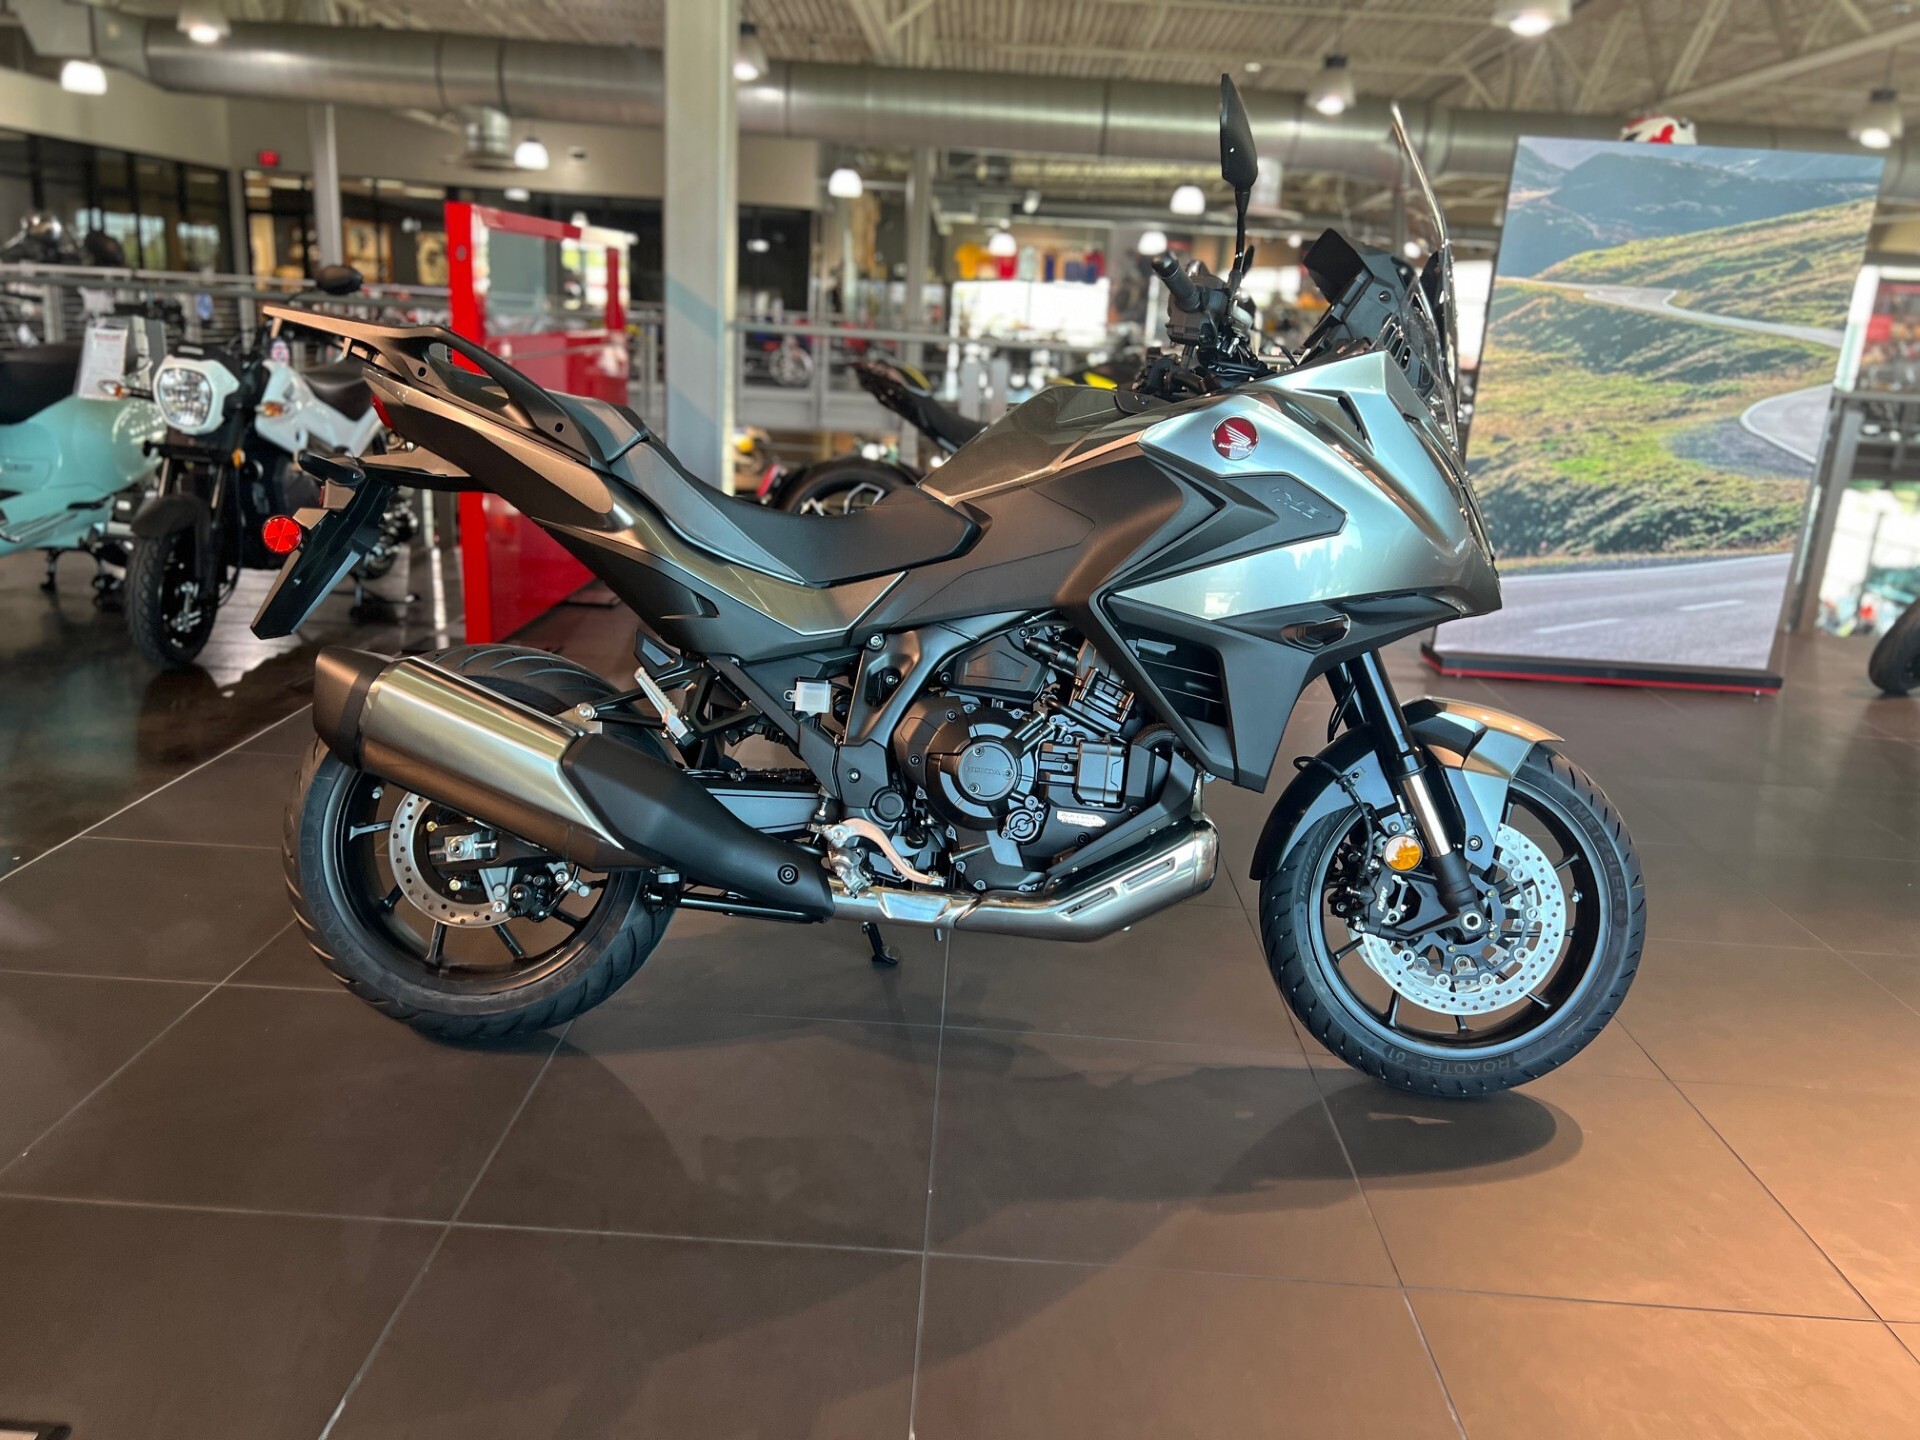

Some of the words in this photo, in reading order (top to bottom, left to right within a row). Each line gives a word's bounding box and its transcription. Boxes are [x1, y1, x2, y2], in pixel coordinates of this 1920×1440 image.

[967, 766, 1001, 776] HONDA
[1570, 799, 1626, 901] METZELER
[1387, 1048, 1407, 1062] 01
[1420, 1058, 1510, 1074] ROADTEC
